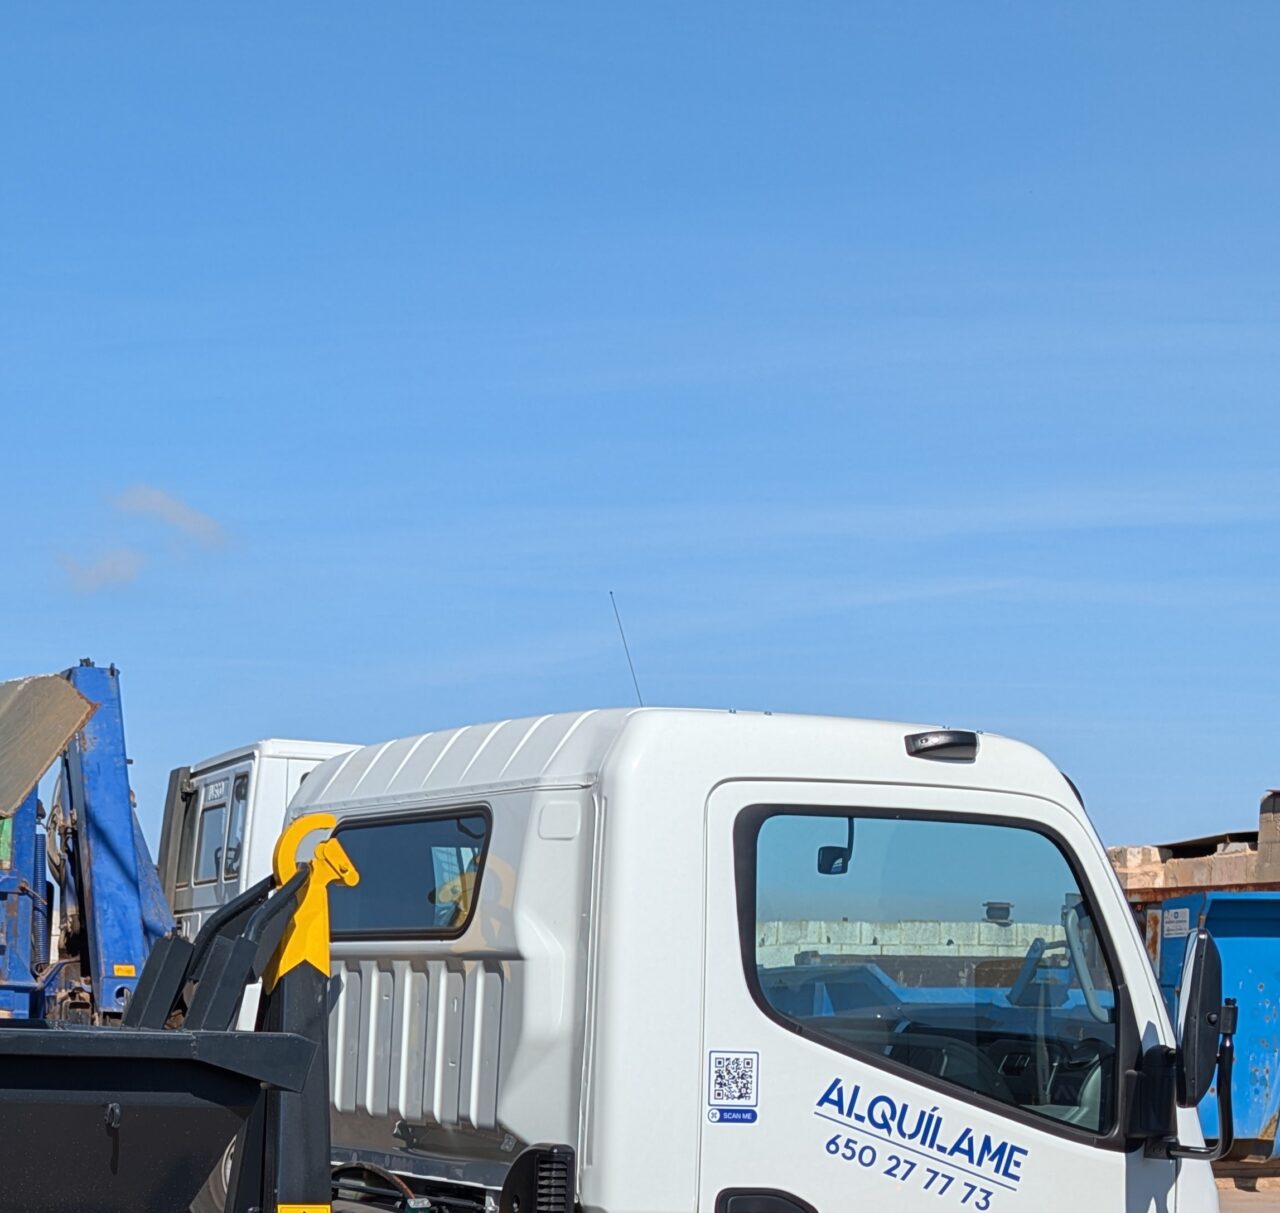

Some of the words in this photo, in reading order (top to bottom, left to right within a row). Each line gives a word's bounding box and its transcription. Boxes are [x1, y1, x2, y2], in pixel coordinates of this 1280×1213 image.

[723, 1112, 741, 1120] SCAN
[742, 1112, 753, 1120] ME
[815, 1076, 1029, 1182] ALQUÍLAME
[825, 1134, 878, 1168] 650
[883, 1154, 917, 1182] 27
[923, 1167, 955, 1196] 77
[960, 1181, 994, 1212] 73
